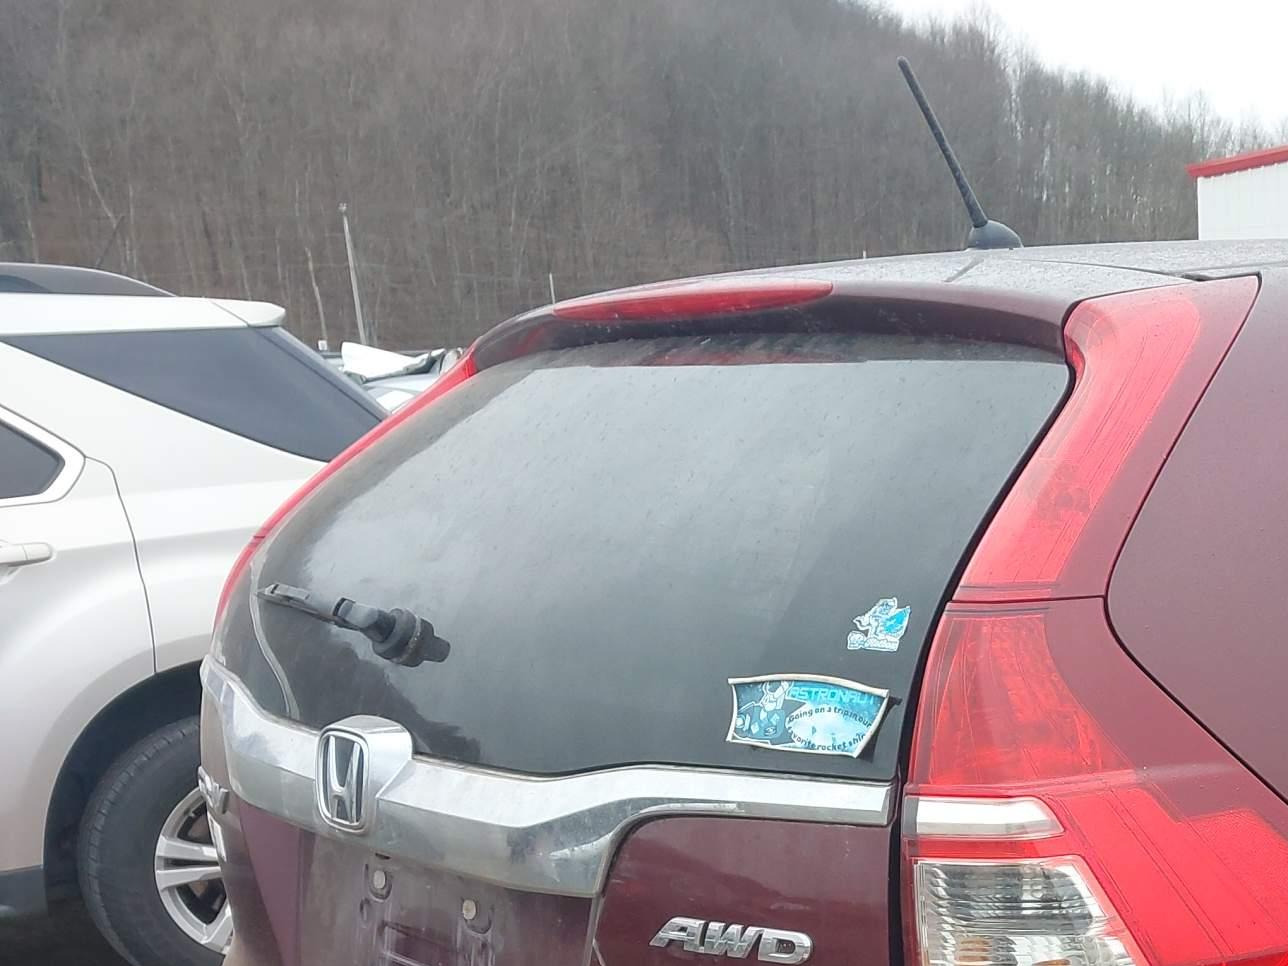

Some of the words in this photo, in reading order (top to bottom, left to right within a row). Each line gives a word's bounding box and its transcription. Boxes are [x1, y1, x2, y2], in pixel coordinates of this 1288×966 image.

[788, 686, 875, 705] ASTRONAUT
[788, 708, 813, 724] Going
[834, 706, 849, 718] trip
[858, 716, 872, 728] our
[816, 742, 848, 752] rocket
[649, 916, 813, 965] AWD
